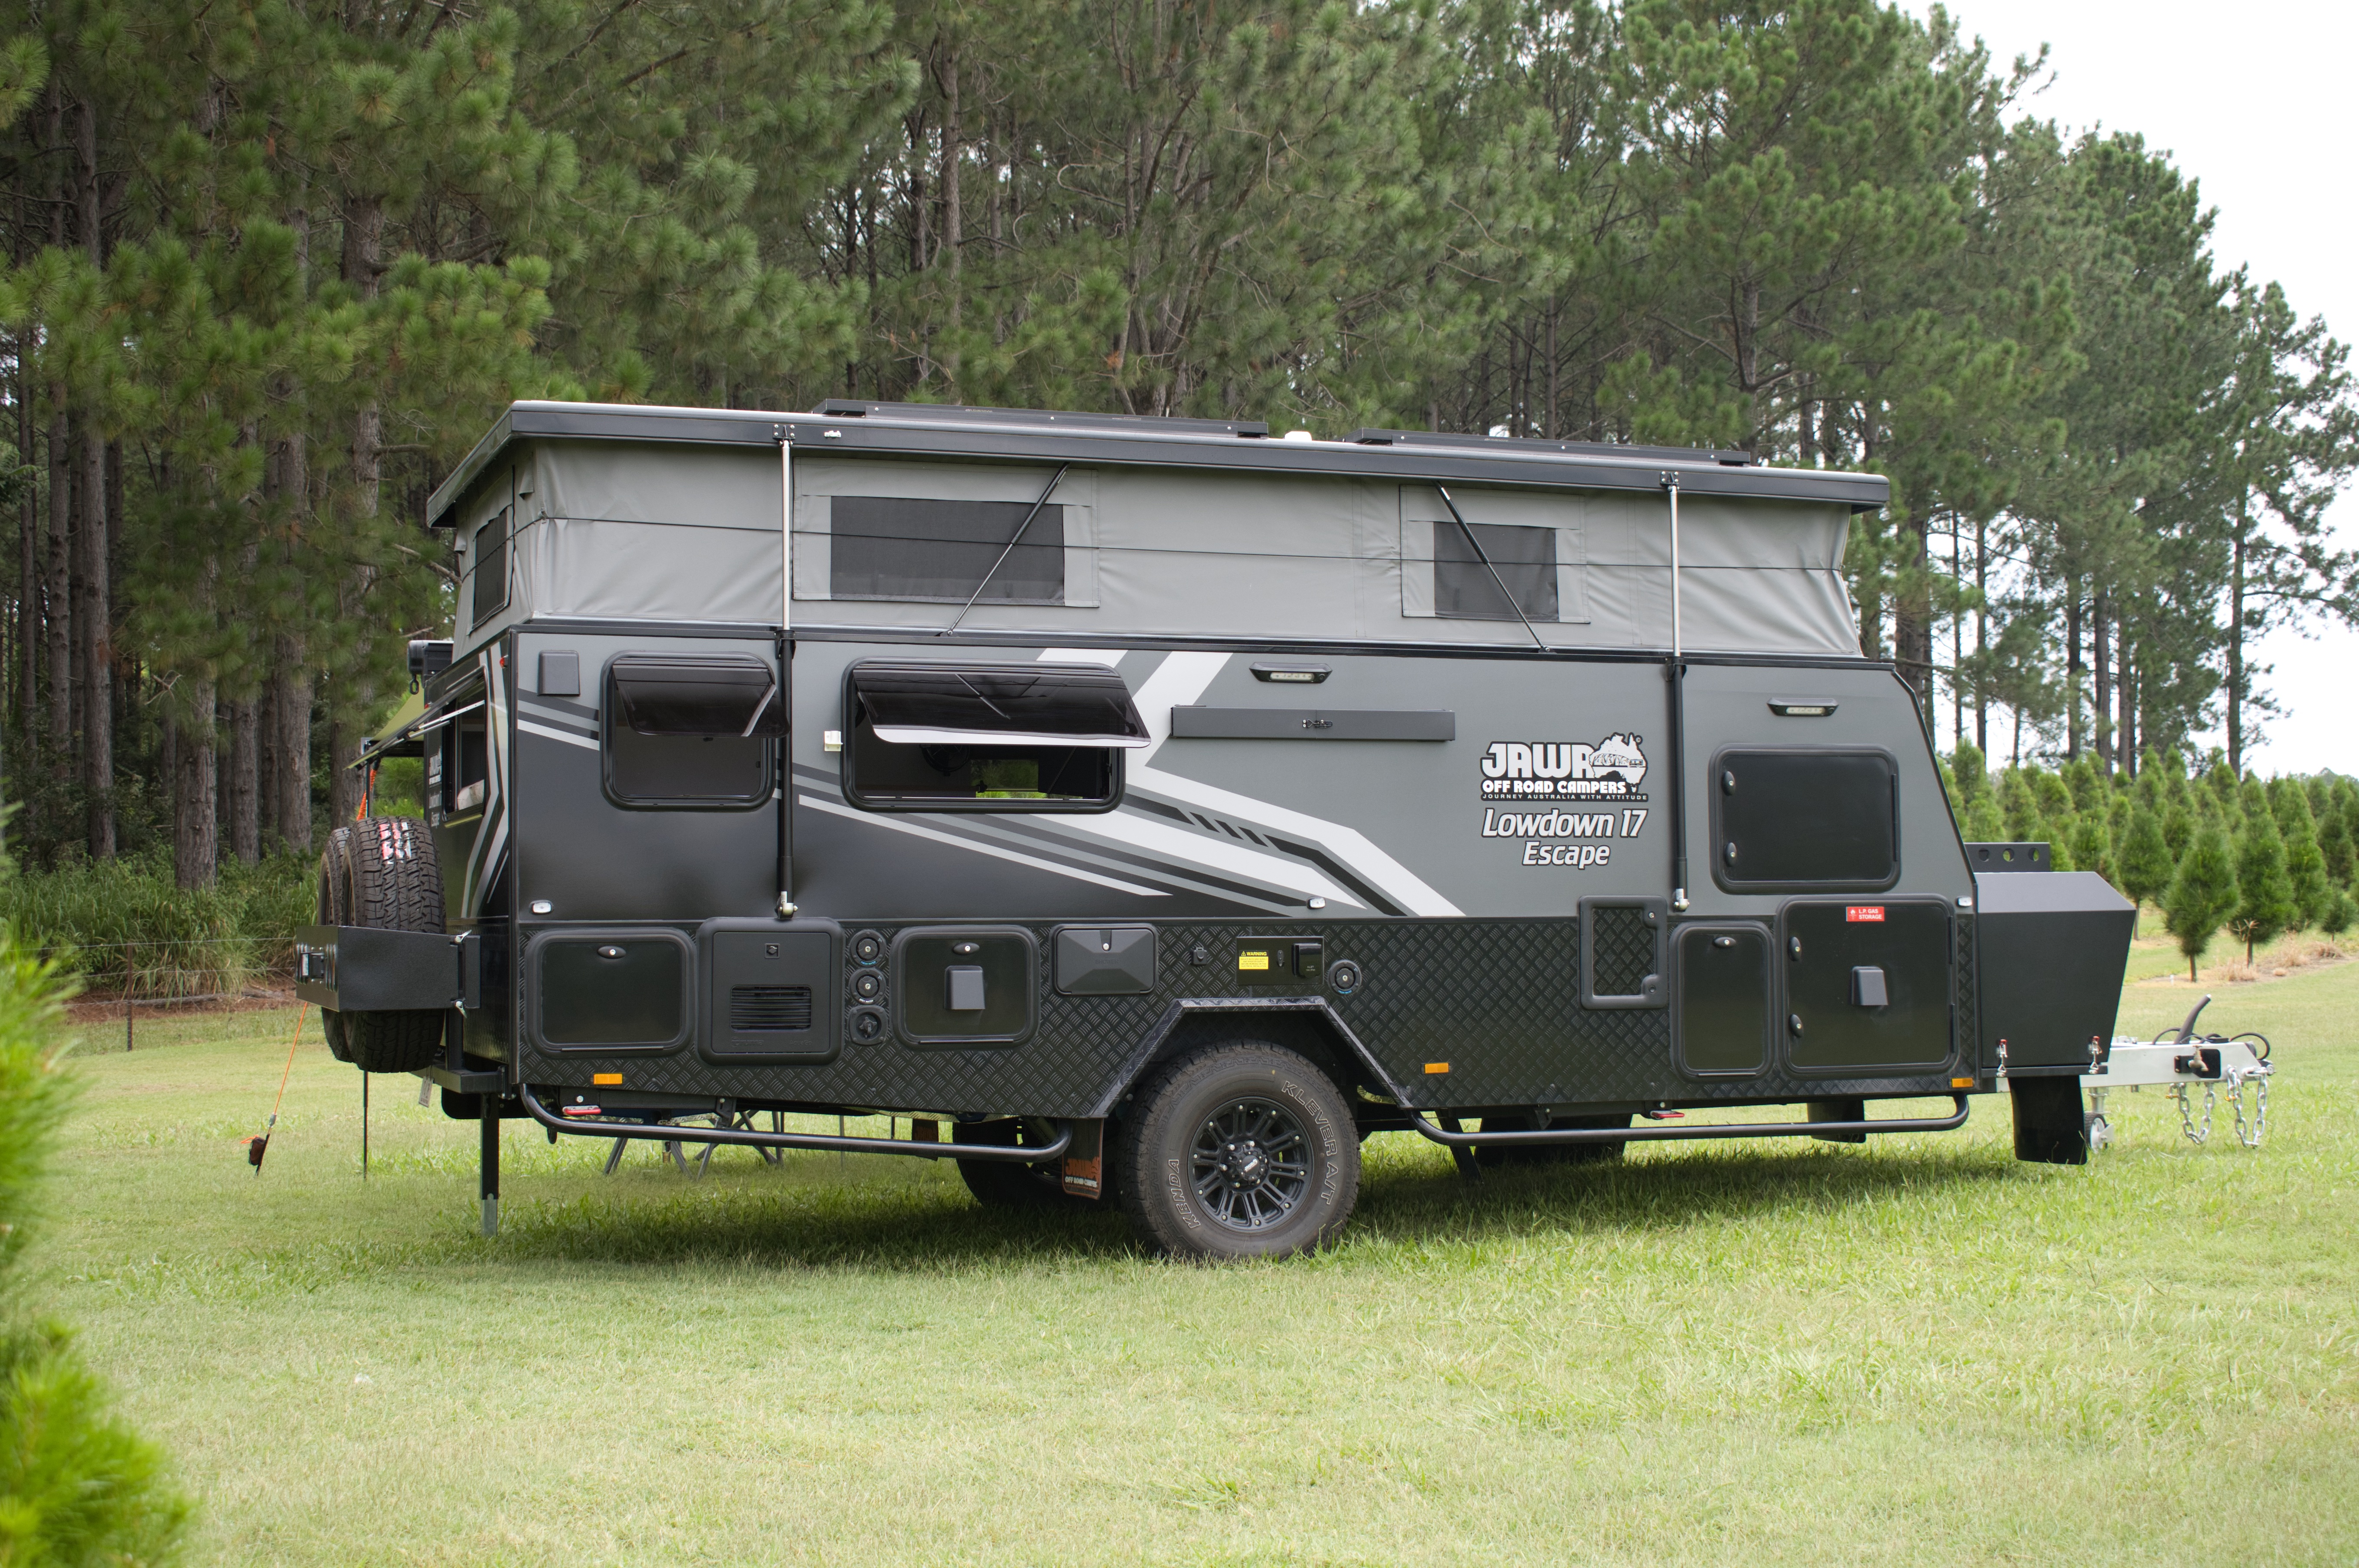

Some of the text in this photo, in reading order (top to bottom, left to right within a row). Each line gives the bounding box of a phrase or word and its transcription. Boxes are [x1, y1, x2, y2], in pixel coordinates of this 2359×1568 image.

[1481, 743, 1597, 779] JAWA
[1482, 780, 1627, 794] OFF ROAD CAMPERS
[1482, 808, 1648, 837] Lowdown 17
[1522, 841, 1610, 869] Escape
[1281, 1081, 1338, 1205] KLEVER A/T
[1168, 1159, 1201, 1228] KENDA
